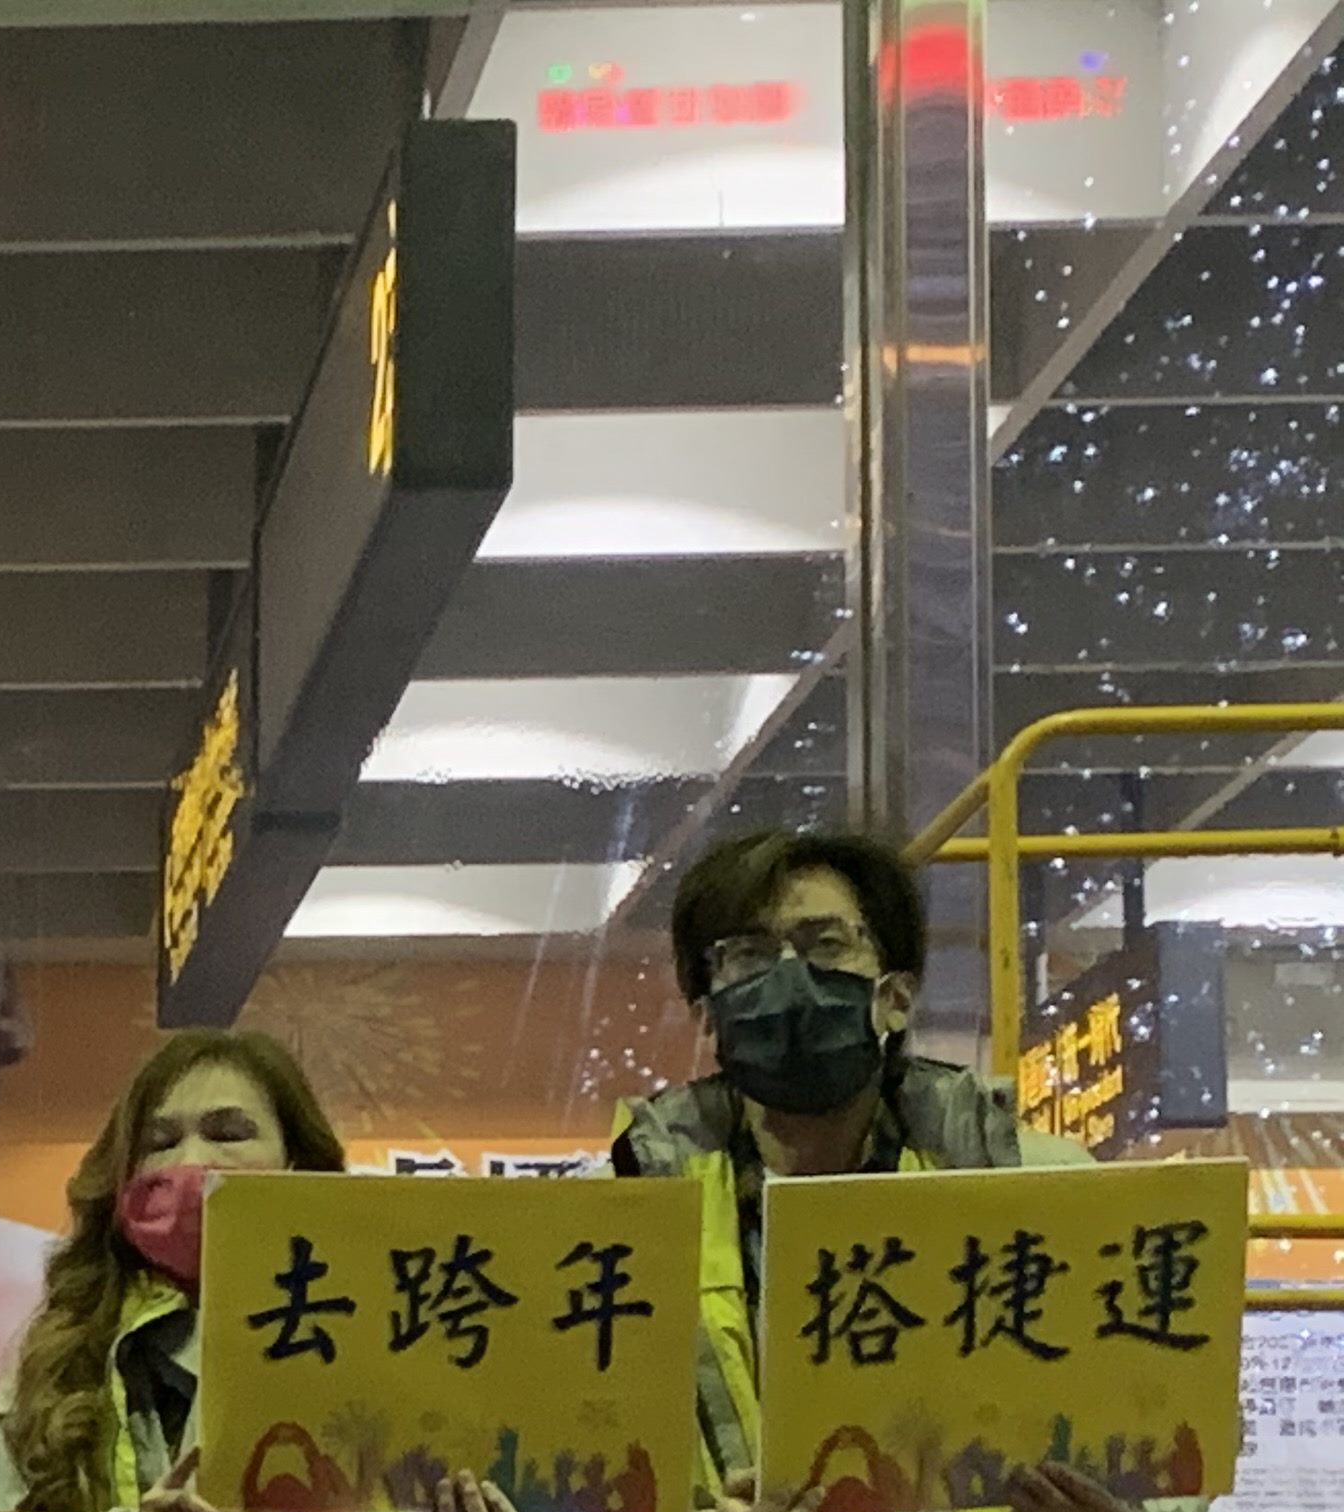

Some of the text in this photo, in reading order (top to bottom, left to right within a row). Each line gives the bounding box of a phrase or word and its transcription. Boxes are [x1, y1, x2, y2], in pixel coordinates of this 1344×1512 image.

[244, 1233, 656, 1372] 去跨年
[799, 1218, 1211, 1367] 搭捷運
